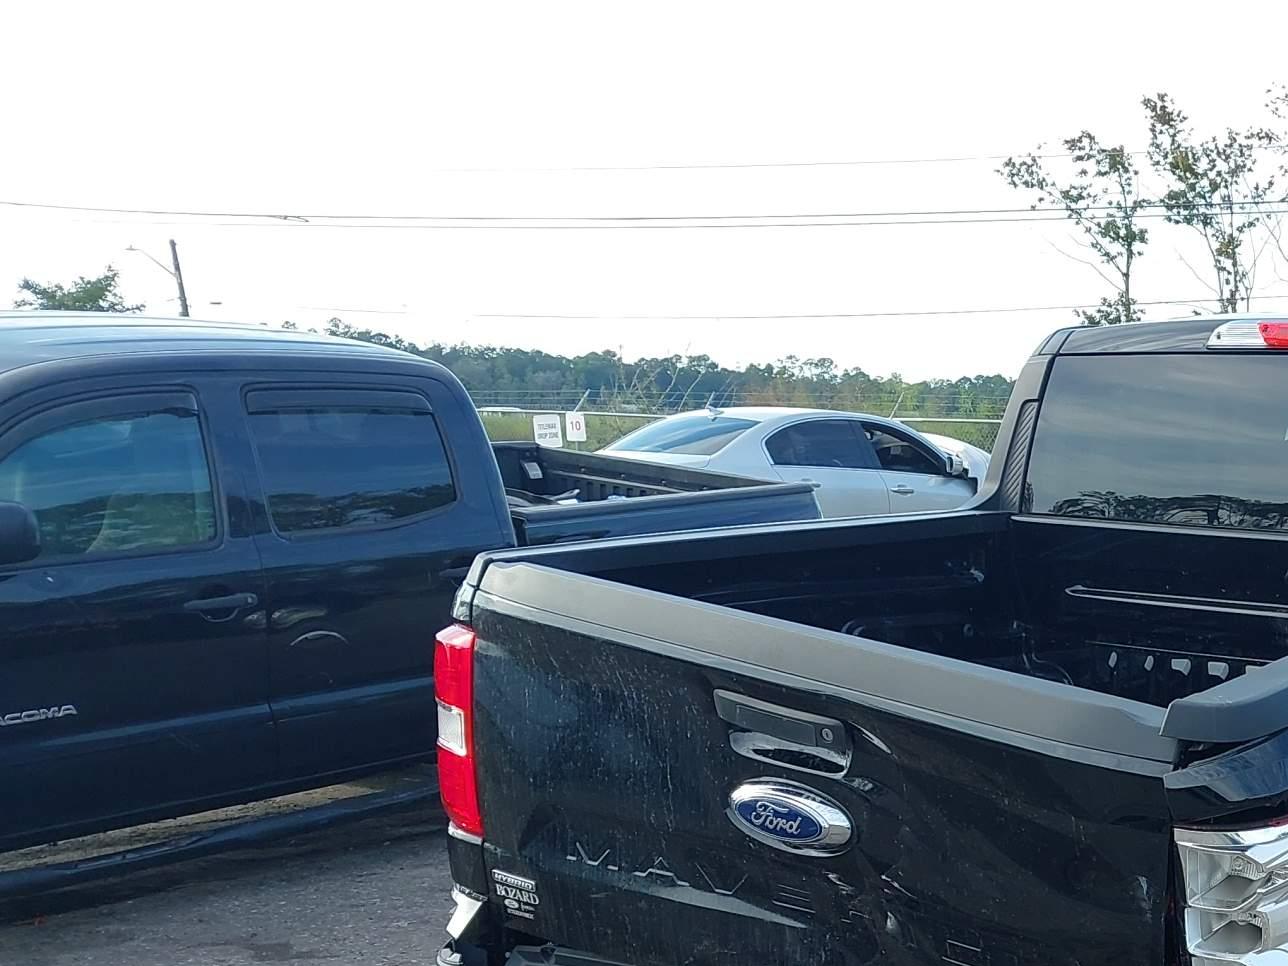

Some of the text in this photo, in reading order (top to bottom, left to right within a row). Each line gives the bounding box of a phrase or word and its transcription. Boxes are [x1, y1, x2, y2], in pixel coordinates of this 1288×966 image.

[570, 420, 582, 431] 10
[0, 704, 78, 726] COMA
[751, 801, 802, 835] Ford
[494, 872, 533, 891] HYBRID
[495, 883, 540, 905] BOZARD
